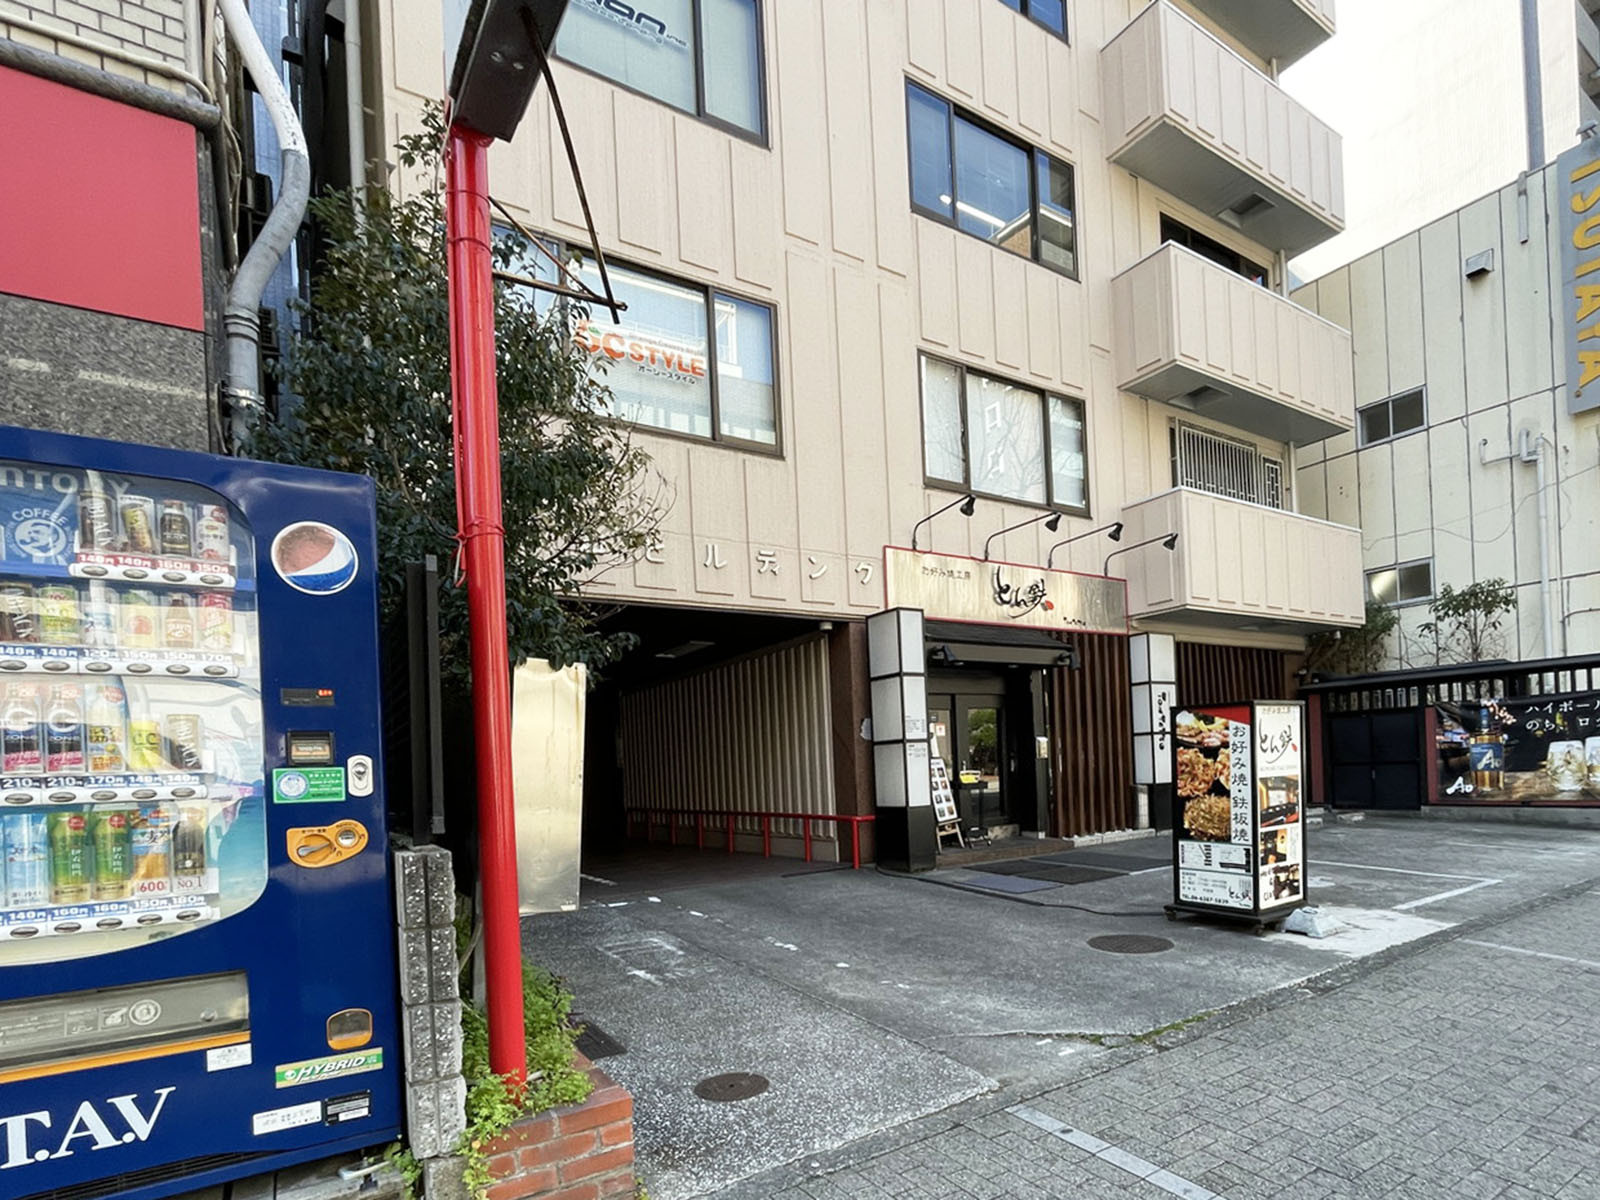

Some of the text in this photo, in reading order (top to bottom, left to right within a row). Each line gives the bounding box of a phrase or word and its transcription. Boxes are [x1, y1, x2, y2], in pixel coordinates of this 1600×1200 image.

[595, 0, 666, 35] an
[629, 342, 705, 377] STYLE
[11, 507, 69, 527] COFFEE
[1477, 749, 1501, 771] Ao
[3, 777, 40, 788] 210円
[47, 776, 84, 787] 210円
[90, 775, 124, 784] 170円
[1231, 725, 1249, 842] お好み焼・鉄板焼
[1446, 776, 1474, 795] Ao
[140, 881, 165, 893] 600
[8, 910, 46, 921] 140円
[296, 1056, 367, 1084] HYBRID
